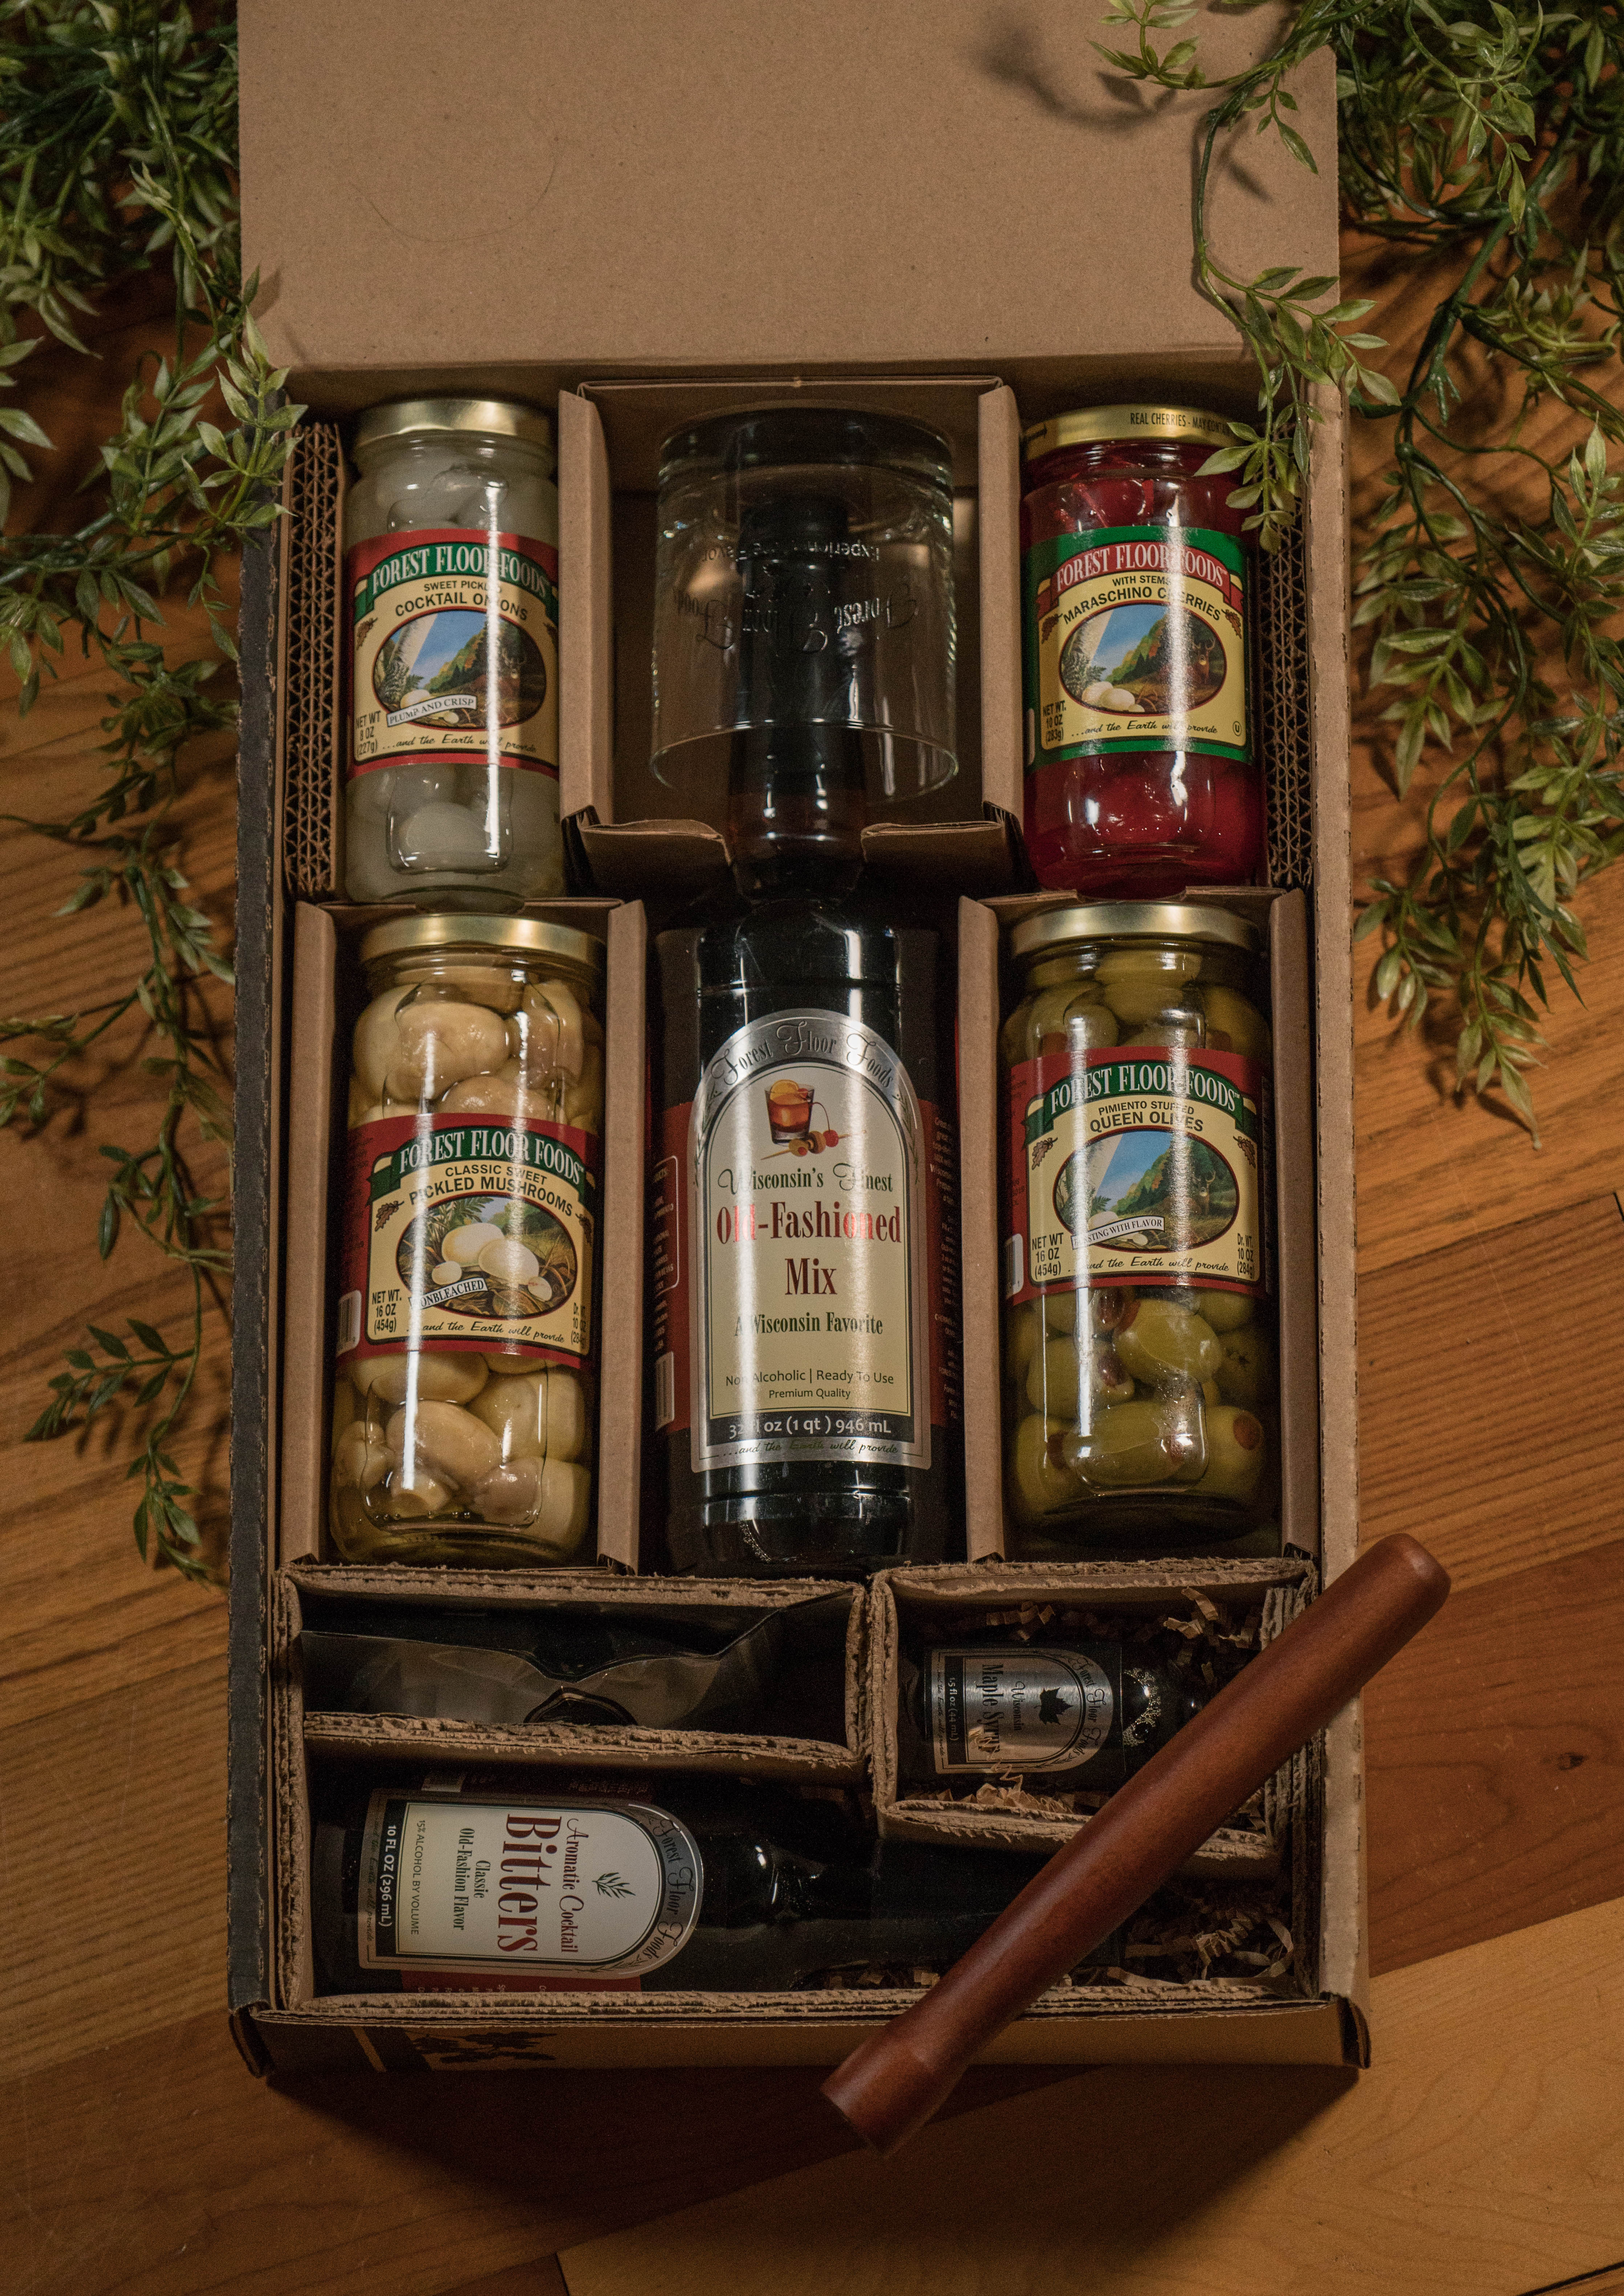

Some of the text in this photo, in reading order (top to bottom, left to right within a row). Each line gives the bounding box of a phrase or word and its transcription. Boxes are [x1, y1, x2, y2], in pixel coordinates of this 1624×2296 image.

[1130, 413, 1148, 424] REAL
[1152, 413, 1186, 427] CHERRIES
[372, 548, 431, 594] FOREST
[1057, 547, 1110, 592] FOREST
[424, 580, 457, 591] SWEET
[1112, 576, 1137, 586] WITH
[395, 592, 467, 617] COCKTAIL
[1063, 586, 1152, 624] MARASCHINO
[389, 698, 474, 724] PLUMP AND CRISP
[1043, 704, 1053, 716] NET
[356, 710, 381, 729] NET WT
[1047, 714, 1063, 729] 10 OZ
[1127, 720, 1157, 730] Earth
[360, 726, 374, 741] 8 OZ
[419, 735, 436, 744] the
[442, 734, 474, 745] Earth
[357, 739, 377, 758] (227g)
[710, 1020, 893, 1089] Forest Floor Foods
[1099, 1101, 1147, 1115] PIMIENTO
[1090, 1112, 1143, 1133] QUEEN
[399, 1131, 464, 1174] FOREST
[470, 1130, 530, 1161] FLOOR
[445, 1164, 502, 1177] CLASSIC
[481, 1176, 573, 1217] MUSHROOMS
[716, 1200, 902, 1244] Old-Fashioned
[1109, 1219, 1162, 1234] WITH FLAVOR
[1032, 1232, 1063, 1251] NET WT
[1036, 1248, 1060, 1262] 16 OZ
[1107, 1258, 1124, 1268] the
[1131, 1256, 1164, 1267] Earth
[1169, 1258, 1191, 1268] will
[1195, 1260, 1229, 1271] provide
[1238, 1247, 1254, 1263] 10 OZ
[784, 1258, 838, 1295] Mix
[1035, 1262, 1061, 1279] (454g)
[1237, 1263, 1255, 1279] (284g)
[372, 1291, 386, 1305] NET
[376, 1306, 396, 1318] 16 OZ
[374, 1319, 397, 1335] (454g)
[573, 1317, 578, 1329] 10
[826, 1312, 883, 1334] Favorite
[448, 1321, 464, 1331] the
[471, 1321, 504, 1333] Earth
[508, 1324, 530, 1337] will
[533, 1331, 564, 1344] provide
[817, 1370, 853, 1383] Ready
[857, 1371, 870, 1382] To
[874, 1372, 894, 1384] Use
[769, 1388, 851, 1400] Premium Quality
[764, 1421, 782, 1432] oz
[787, 1416, 799, 1434] (1
[803, 1418, 821, 1434] qt
[836, 1419, 864, 1434] 946
[869, 1420, 891, 1433] mL
[765, 1442, 781, 1450] the
[830, 1440, 856, 1450] will
[859, 1443, 897, 1454] provide
[976, 1664, 1004, 1706] Maple
[950, 1697, 955, 1706] oz
[1012, 1680, 1026, 1731] Wisconsin
[378, 1825, 397, 1927] 10 FL OZ (296 mL)
[411, 1820, 426, 1935] 15% ALCOHOL BY VOLUME
[453, 1828, 475, 1931] Old-Fashion Flavor
[474, 1860, 491, 1899] Classic
[497, 1813, 562, 1952] Bitters
[559, 1818, 589, 1953] Aromatic Cocktail
[666, 1866, 694, 1915] Floor
